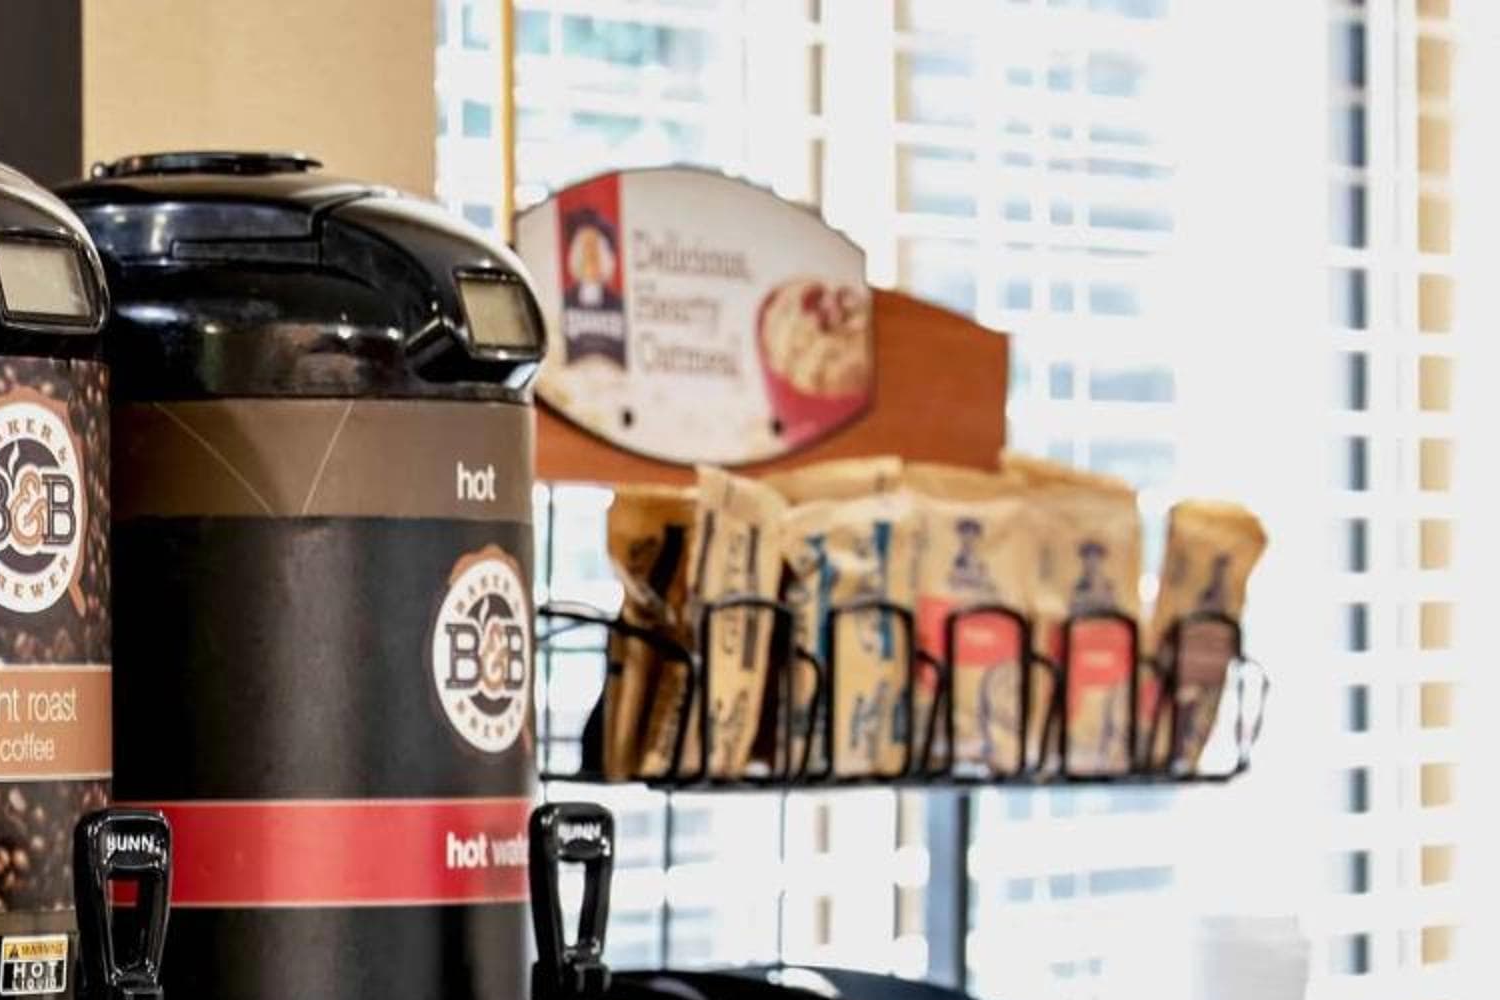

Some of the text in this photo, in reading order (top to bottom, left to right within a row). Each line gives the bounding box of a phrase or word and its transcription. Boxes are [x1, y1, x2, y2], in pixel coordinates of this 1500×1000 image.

[456, 460, 496, 502] hot
[27, 687, 78, 722] roast
[0, 732, 56, 762] coffee
[446, 831, 488, 869] hot
[13, 960, 58, 979] HOT
